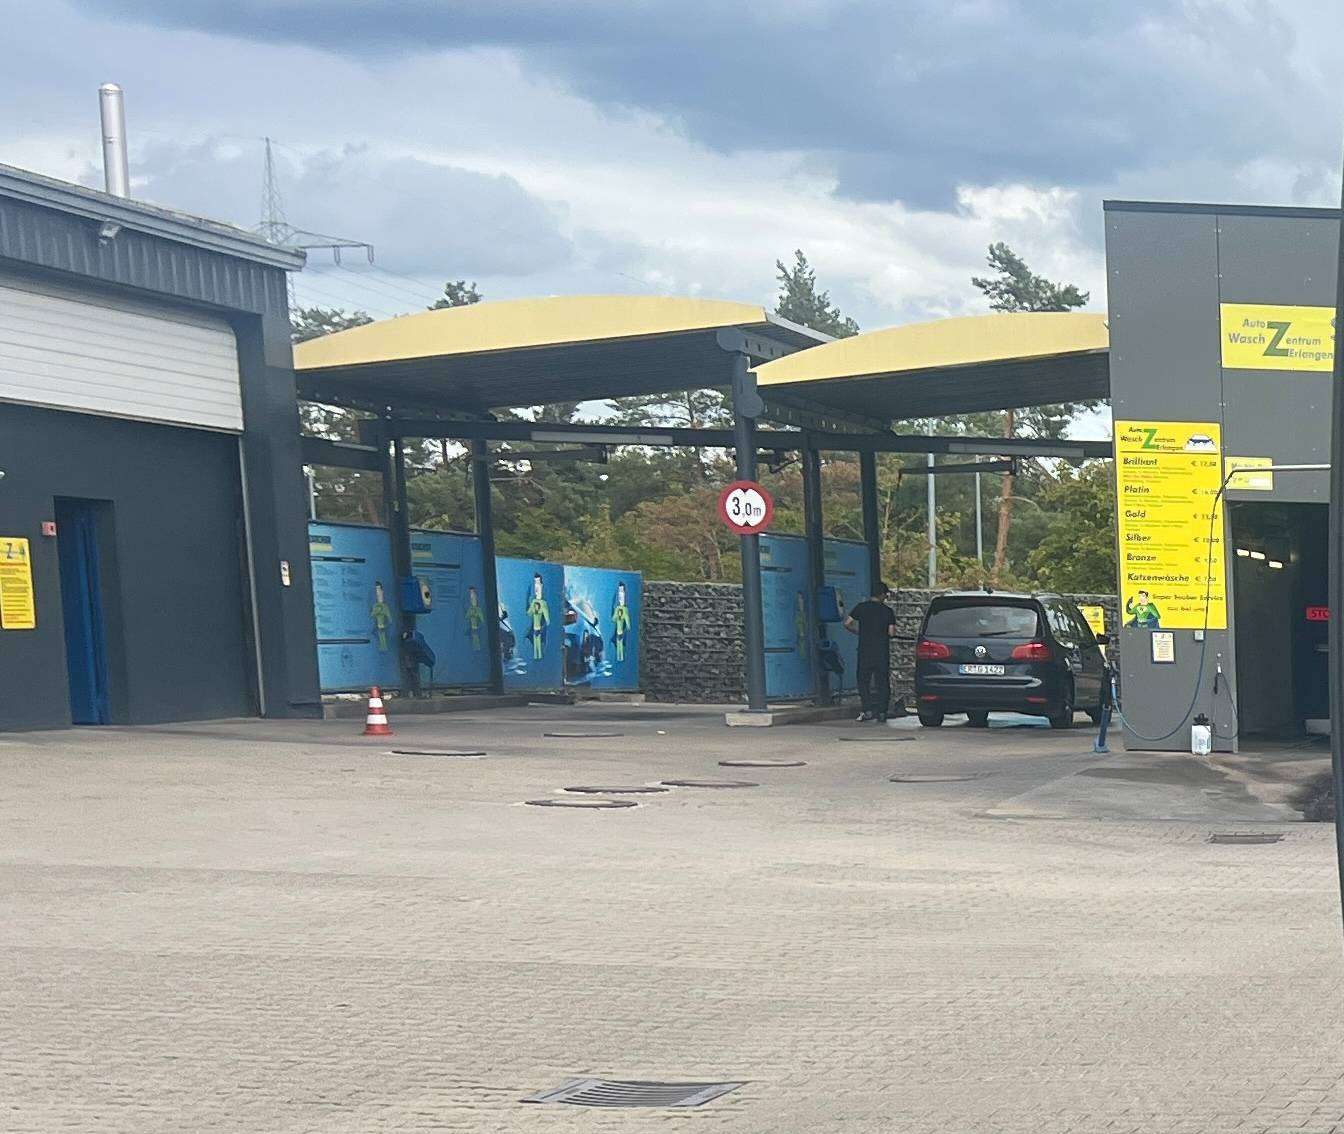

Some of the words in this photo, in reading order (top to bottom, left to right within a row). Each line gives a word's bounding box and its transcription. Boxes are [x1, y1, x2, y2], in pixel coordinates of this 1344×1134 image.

[1242, 318, 1265, 328] Auto
[1228, 332, 1265, 344] Wasch
[1288, 349, 1334, 361] Erlangen
[1124, 485, 1150, 494] Platin
[1125, 510, 1146, 518] Gold
[1125, 534, 1151, 542] Silber
